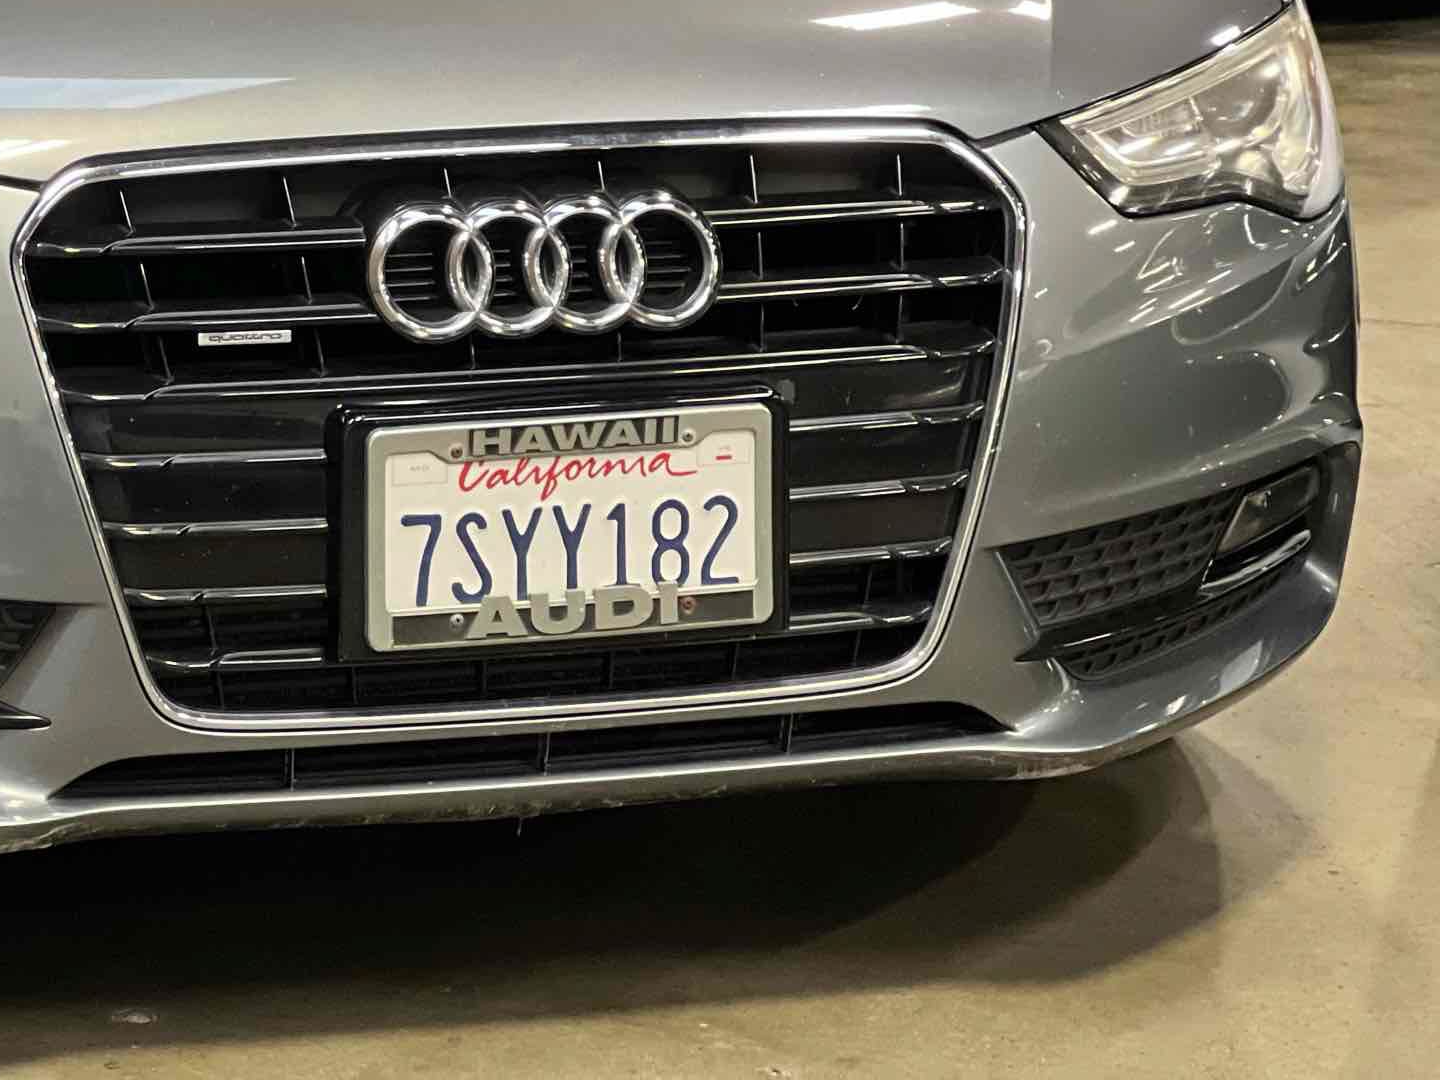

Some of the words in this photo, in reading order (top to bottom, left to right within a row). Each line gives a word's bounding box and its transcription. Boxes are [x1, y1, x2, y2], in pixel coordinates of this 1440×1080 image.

[472, 417, 680, 456] HAWAII
[459, 451, 697, 501] California
[400, 495, 740, 608] 7SYY182
[464, 581, 679, 640] AUDI
